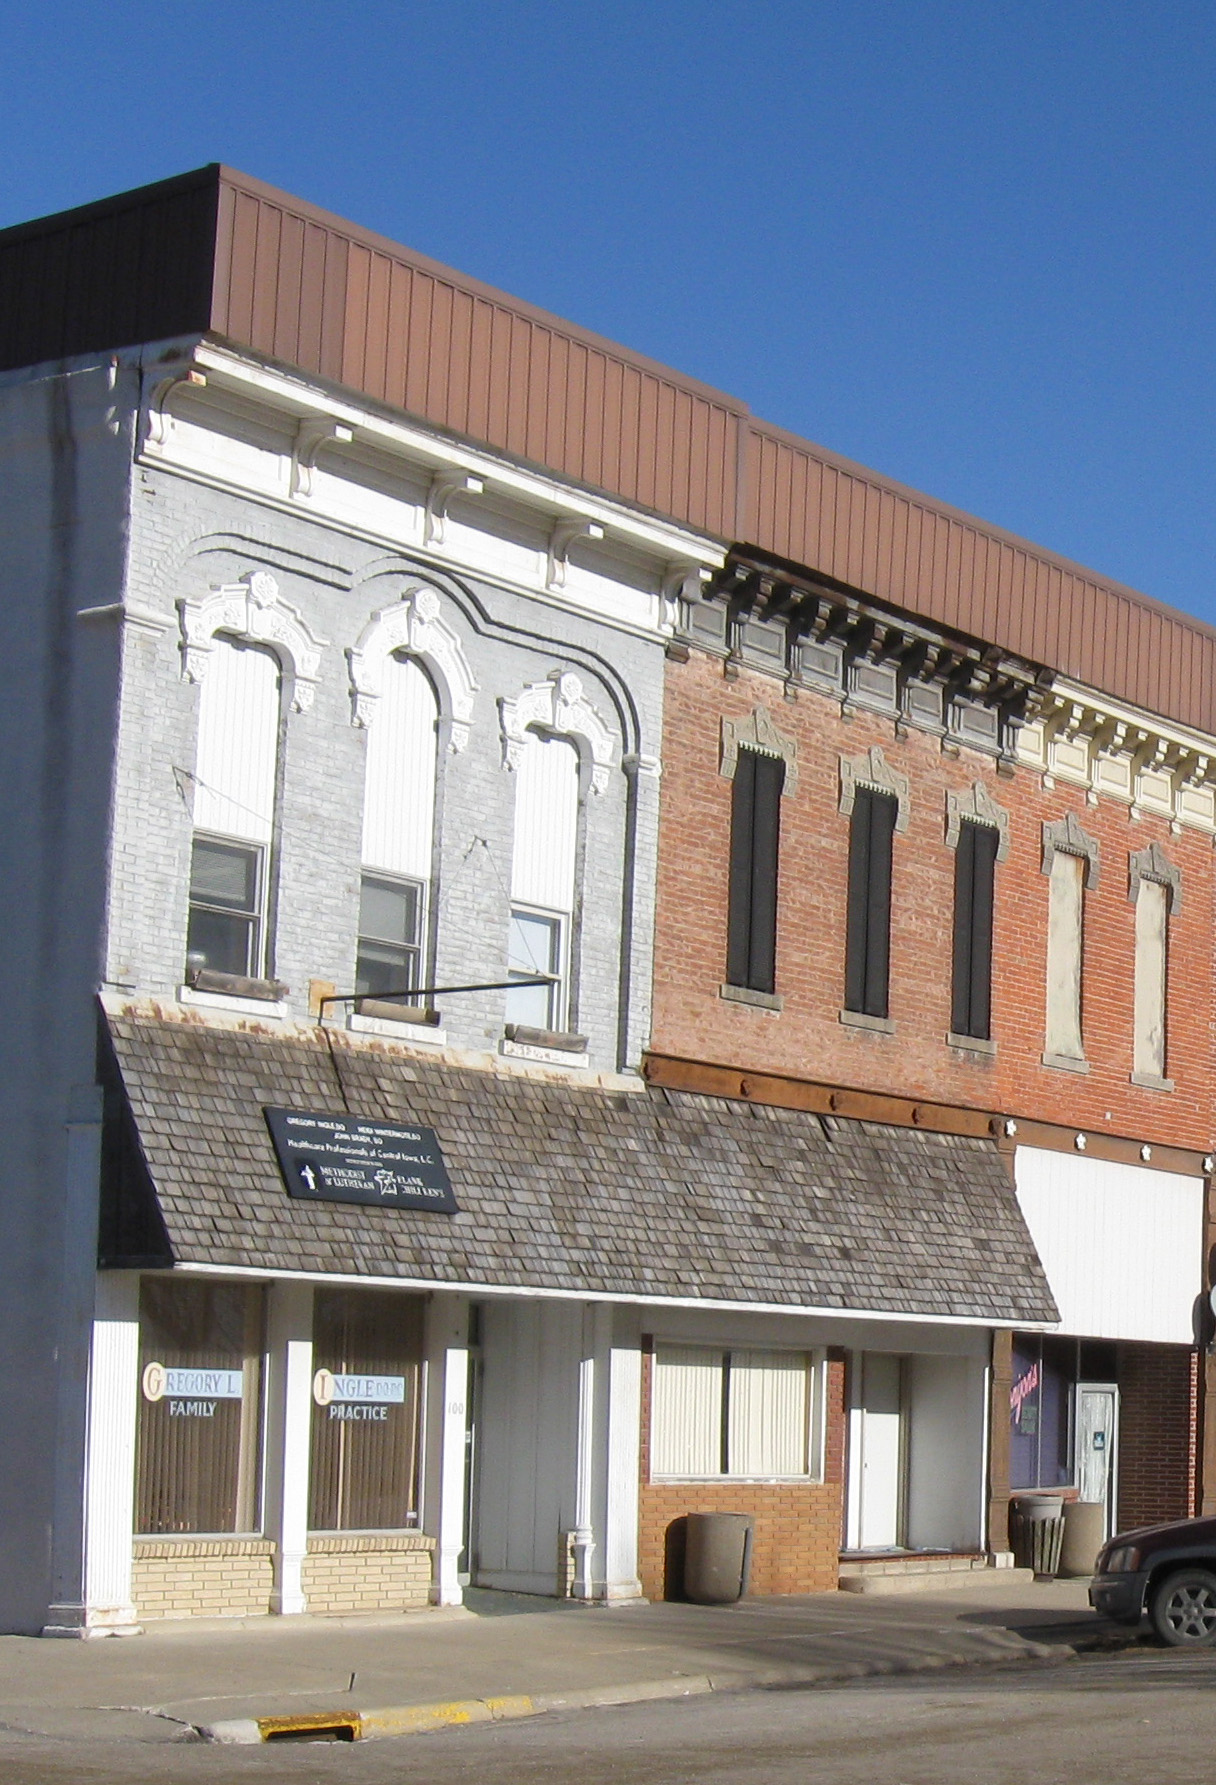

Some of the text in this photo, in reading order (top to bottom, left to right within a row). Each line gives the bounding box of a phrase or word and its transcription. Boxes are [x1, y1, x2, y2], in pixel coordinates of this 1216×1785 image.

[287, 1138, 325, 1152] Healthcare
[326, 1143, 369, 1157] Professionals
[370, 1148, 376, 1158] of
[377, 1149, 401, 1160] Central
[320, 1165, 366, 1178] METHODIST
[333, 1177, 375, 1190] LUTHERAN
[396, 1174, 424, 1186] BLANK
[147, 1367, 222, 1395] GREGORY
[319, 1374, 375, 1400] INGLE
[169, 1401, 217, 1417] FAMILY
[329, 1405, 388, 1420] PRACTICE
[448, 1402, 464, 1415] 100
